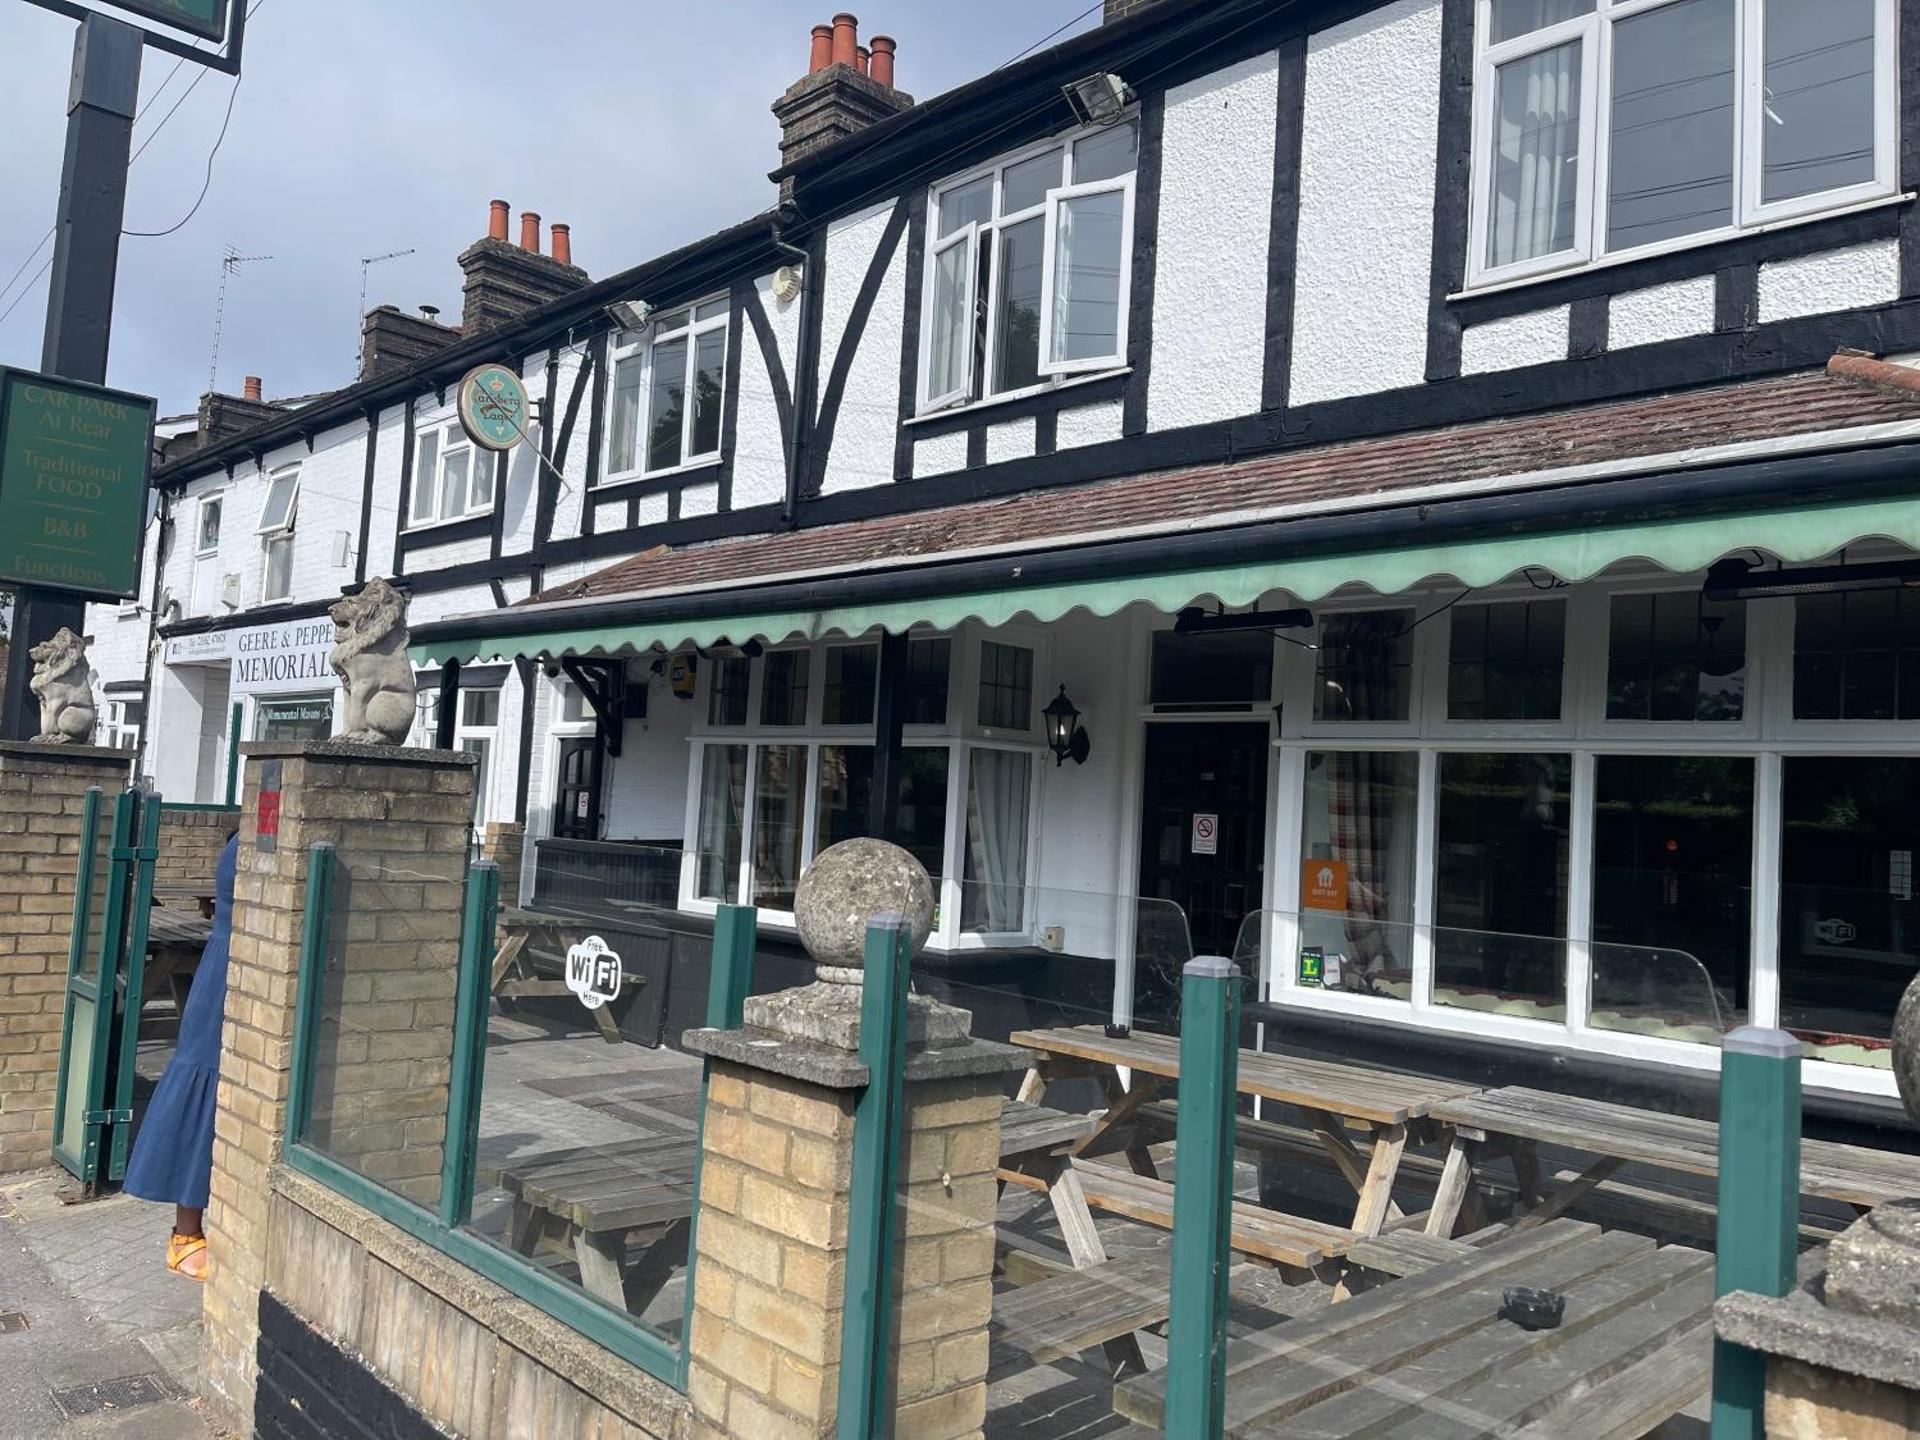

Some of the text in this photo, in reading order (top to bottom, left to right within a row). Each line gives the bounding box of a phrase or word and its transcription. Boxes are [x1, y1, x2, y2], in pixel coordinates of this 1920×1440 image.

[24, 385, 129, 421] CAR PARK
[39, 412, 112, 438] At Rear
[23, 450, 122, 483] Traditional
[35, 475, 102, 500] FOOD
[43, 516, 88, 539] B&B
[15, 554, 107, 585] Functions
[239, 630, 277, 652] GEERE
[281, 631, 291, 648] &
[295, 623, 334, 647] PEPPE
[236, 651, 337, 683] MEMORIAL
